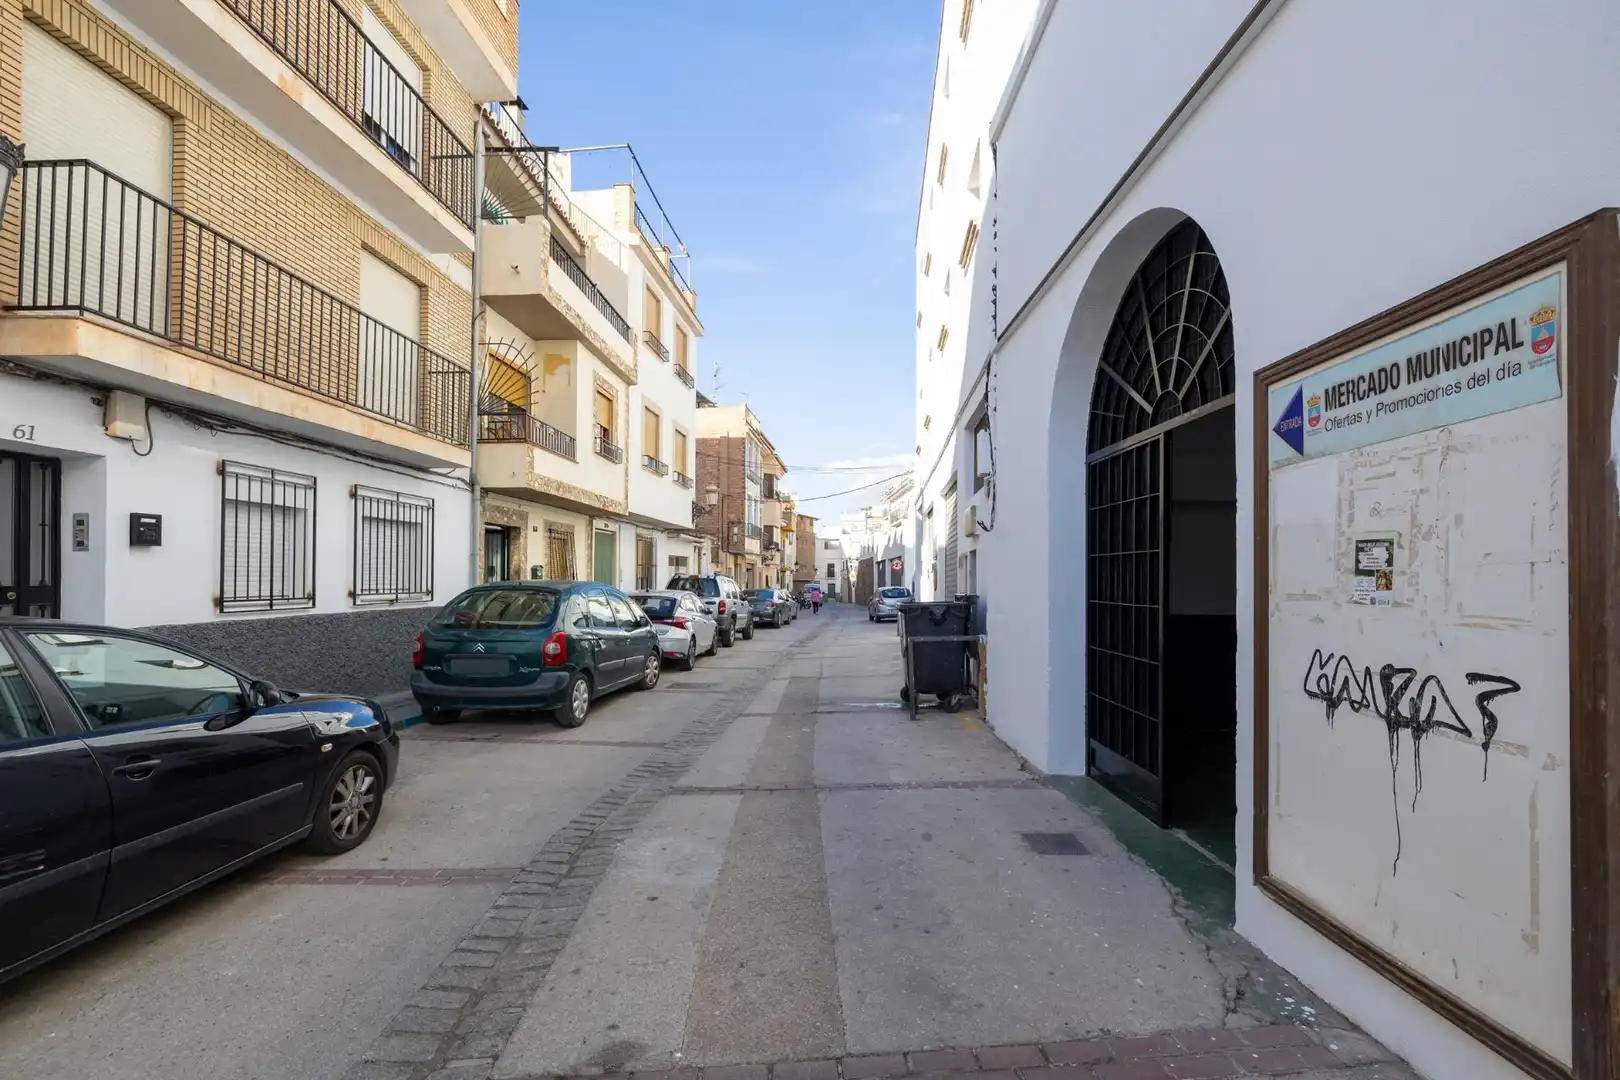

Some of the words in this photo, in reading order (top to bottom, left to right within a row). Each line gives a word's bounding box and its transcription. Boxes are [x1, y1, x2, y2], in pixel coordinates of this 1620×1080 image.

[1324, 362, 1400, 412] MERCADO
[1406, 317, 1524, 385] MUNICIPAL
[1324, 411, 1363, 432] Ofertas
[1366, 408, 1373, 424] y
[1375, 380, 1462, 418] Promociones
[1466, 367, 1490, 390] del
[1495, 360, 1522, 381] día
[13, 423, 36, 441] 61
[1279, 415, 1303, 433] ENTRADA
